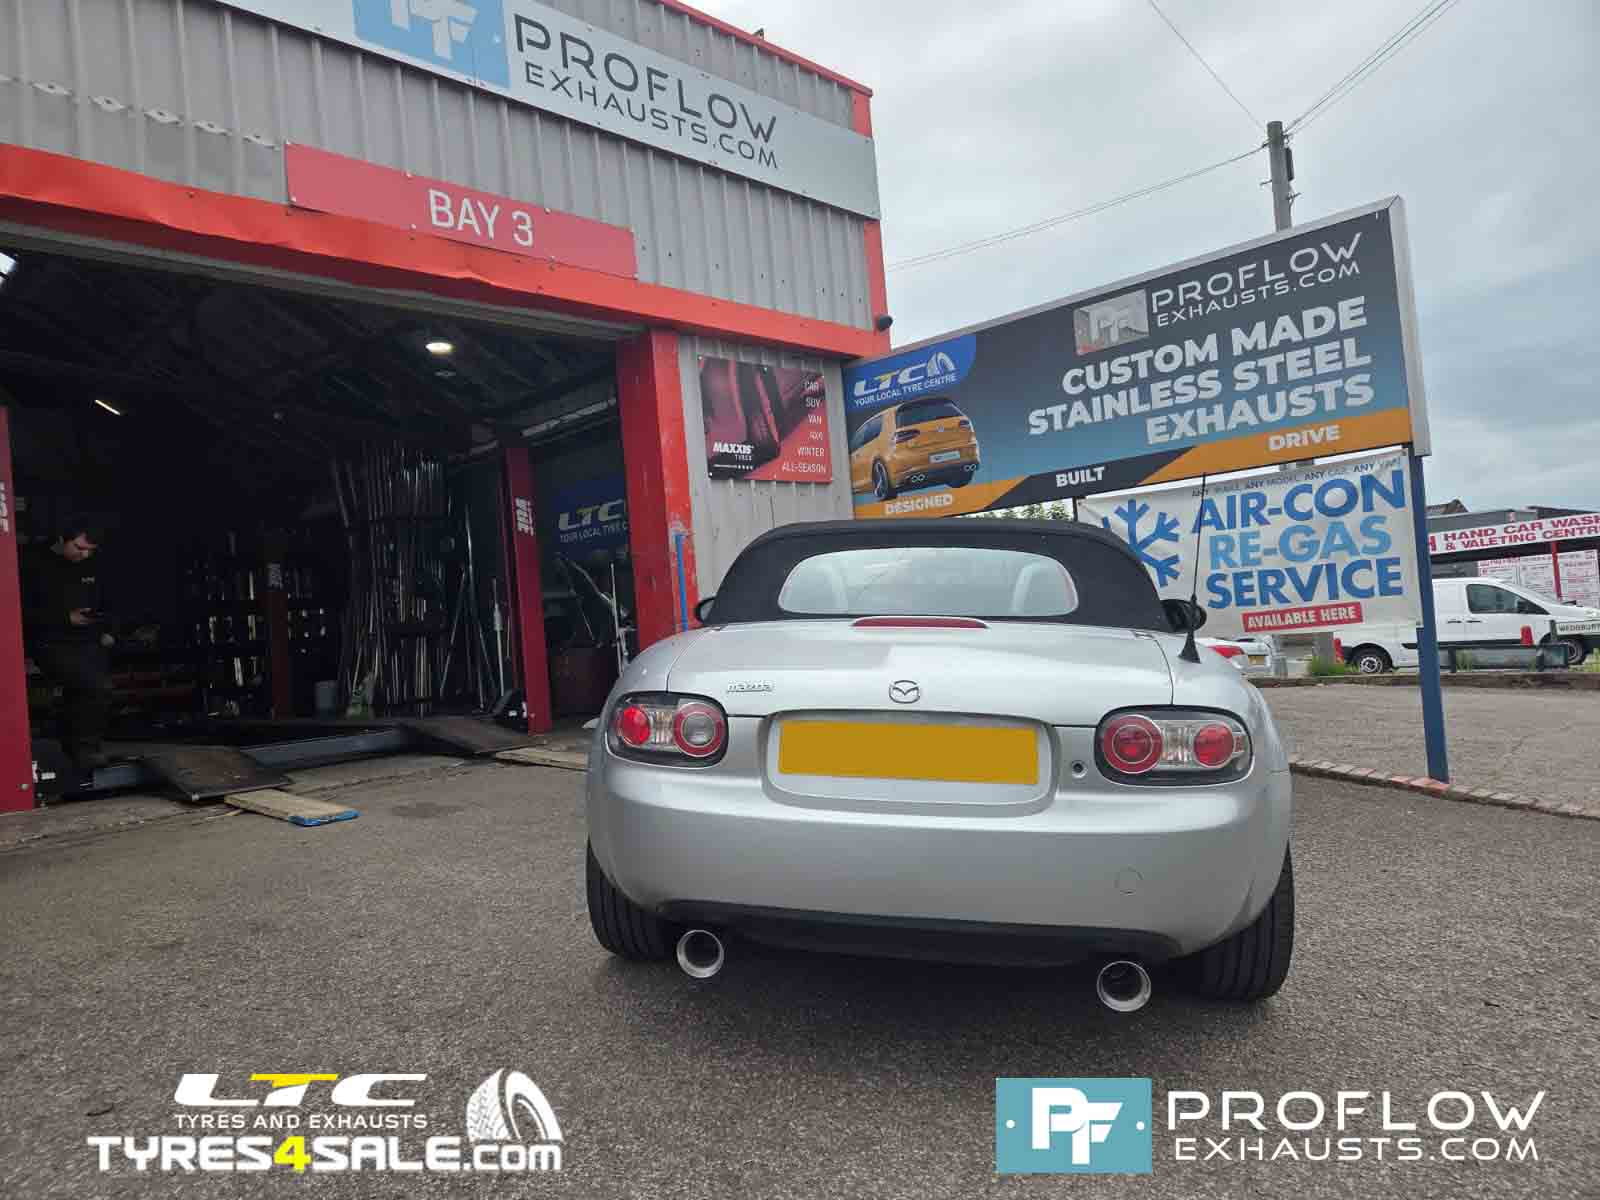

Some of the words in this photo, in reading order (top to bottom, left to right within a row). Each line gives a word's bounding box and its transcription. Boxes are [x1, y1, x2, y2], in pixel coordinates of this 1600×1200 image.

[514, 14, 777, 144] PROFLOW
[526, 63, 778, 169] EXHAUSTS.COM
[429, 189, 500, 240] BAY
[512, 210, 534, 247] 3
[1151, 232, 1363, 313] PROFLOW
[1157, 259, 1360, 328] EXHAUSTS.COM
[1062, 332, 1219, 395] CUSTOM
[1231, 296, 1368, 357] MADE
[804, 381, 819, 391] CAR
[854, 363, 927, 396] LTC
[854, 395, 875, 406] YOUR
[876, 388, 901, 401] LOCAL
[902, 383, 923, 394] TYRE
[924, 374, 957, 389] CENTRE
[1029, 370, 1222, 435] STAINLESS
[1233, 336, 1372, 391] STEEL
[805, 397, 821, 408] SUV
[1146, 374, 1375, 445] EXHAUSTS
[808, 414, 822, 425] VAN
[712, 441, 752, 454] MAXXIS
[797, 447, 825, 457] WINTER
[1268, 425, 1342, 452] DRIVE
[782, 462, 827, 473] ALL-SEASON
[1056, 466, 1105, 488] BUILT
[1353, 463, 1375, 473] ANY
[559, 499, 623, 531] LTC
[885, 493, 953, 515] DESIGNED
[1191, 469, 1408, 534] AIR-CON
[1210, 515, 1392, 571] RE-GAS
[1444, 527, 1497, 542] HAND
[1504, 522, 1543, 536] CAR
[1445, 541, 1456, 551] &
[1462, 534, 1536, 549] VALETING
[1542, 526, 1600, 540] CENTR
[1206, 556, 1403, 610] SERVICE
[1247, 609, 1316, 629] AVAILABLE
[1320, 605, 1357, 622] HERE
